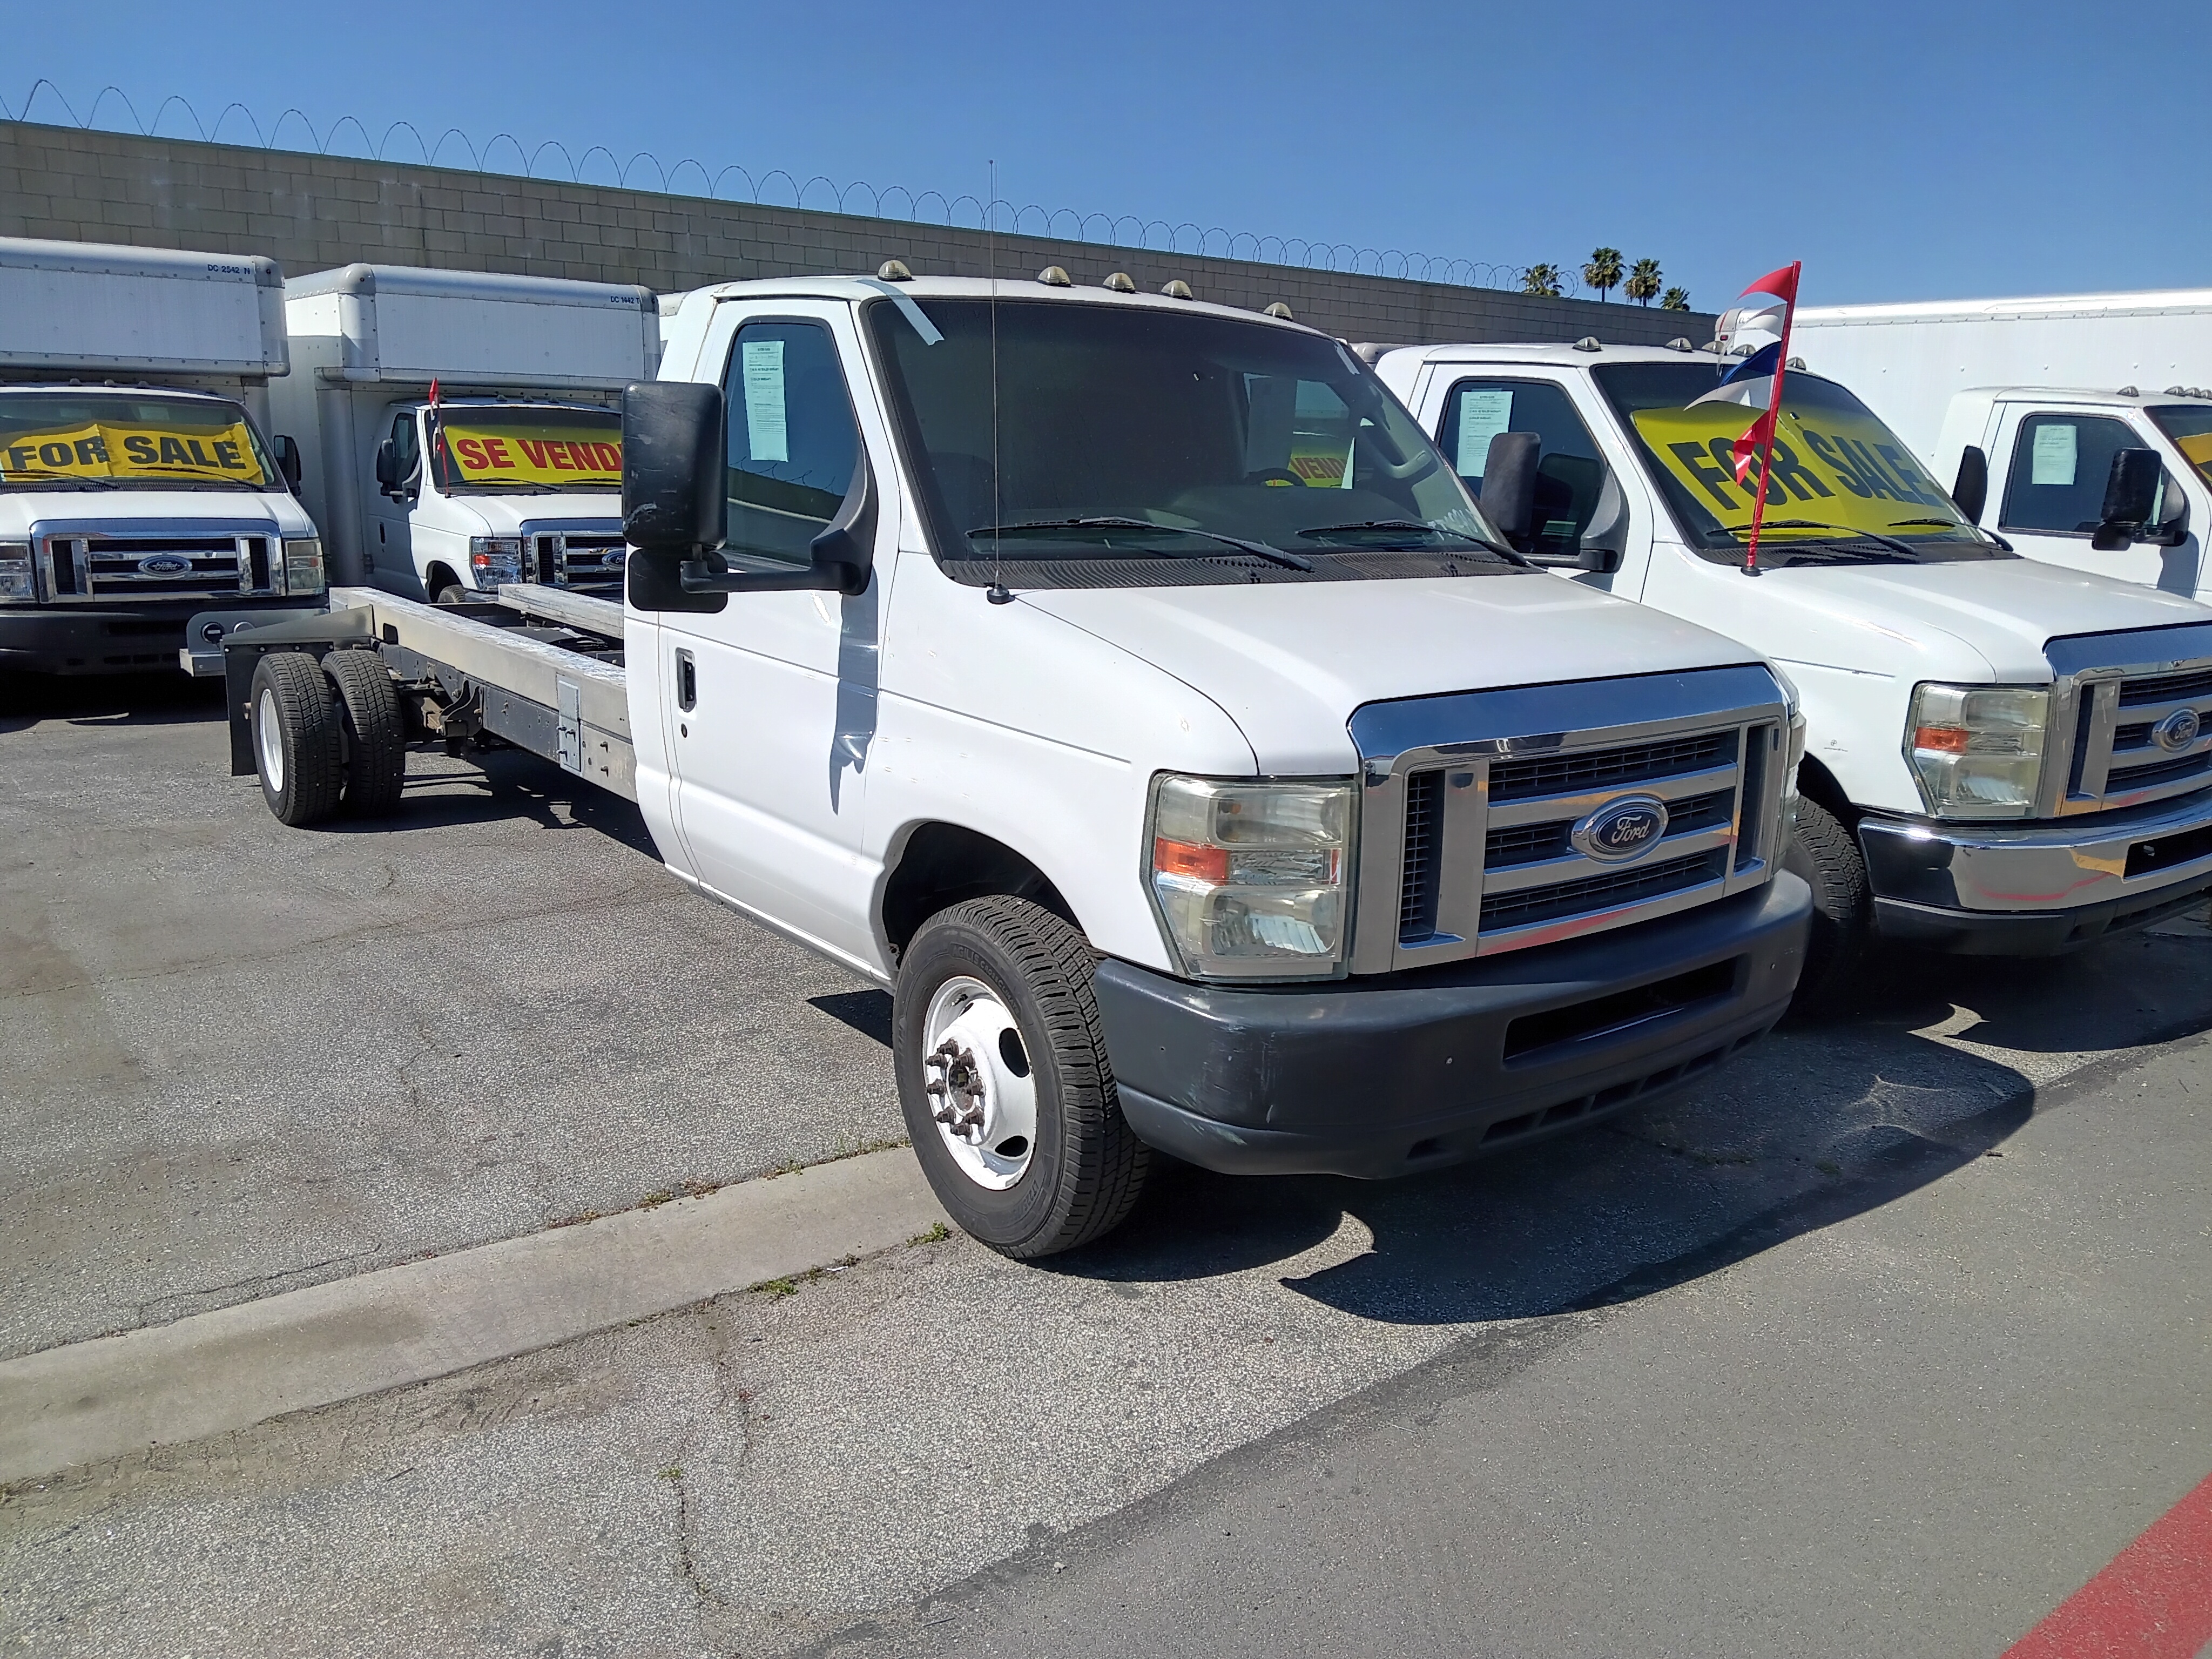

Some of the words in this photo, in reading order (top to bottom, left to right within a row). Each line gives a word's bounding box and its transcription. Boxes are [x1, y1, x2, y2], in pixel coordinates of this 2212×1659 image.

[221, 266, 240, 274] 2542
[8, 436, 111, 470] FOR
[123, 435, 247, 470] SALE
[456, 439, 516, 470] SE
[515, 439, 622, 471] VEND
[1290, 457, 1347, 480] VEND
[1667, 437, 1836, 510] FOR
[1802, 427, 1946, 508] SALE
[154, 561, 178, 571] Ford
[2174, 721, 2195, 739] Ford
[1611, 815, 1651, 844] Ford
[953, 945, 980, 966] AGILIS
